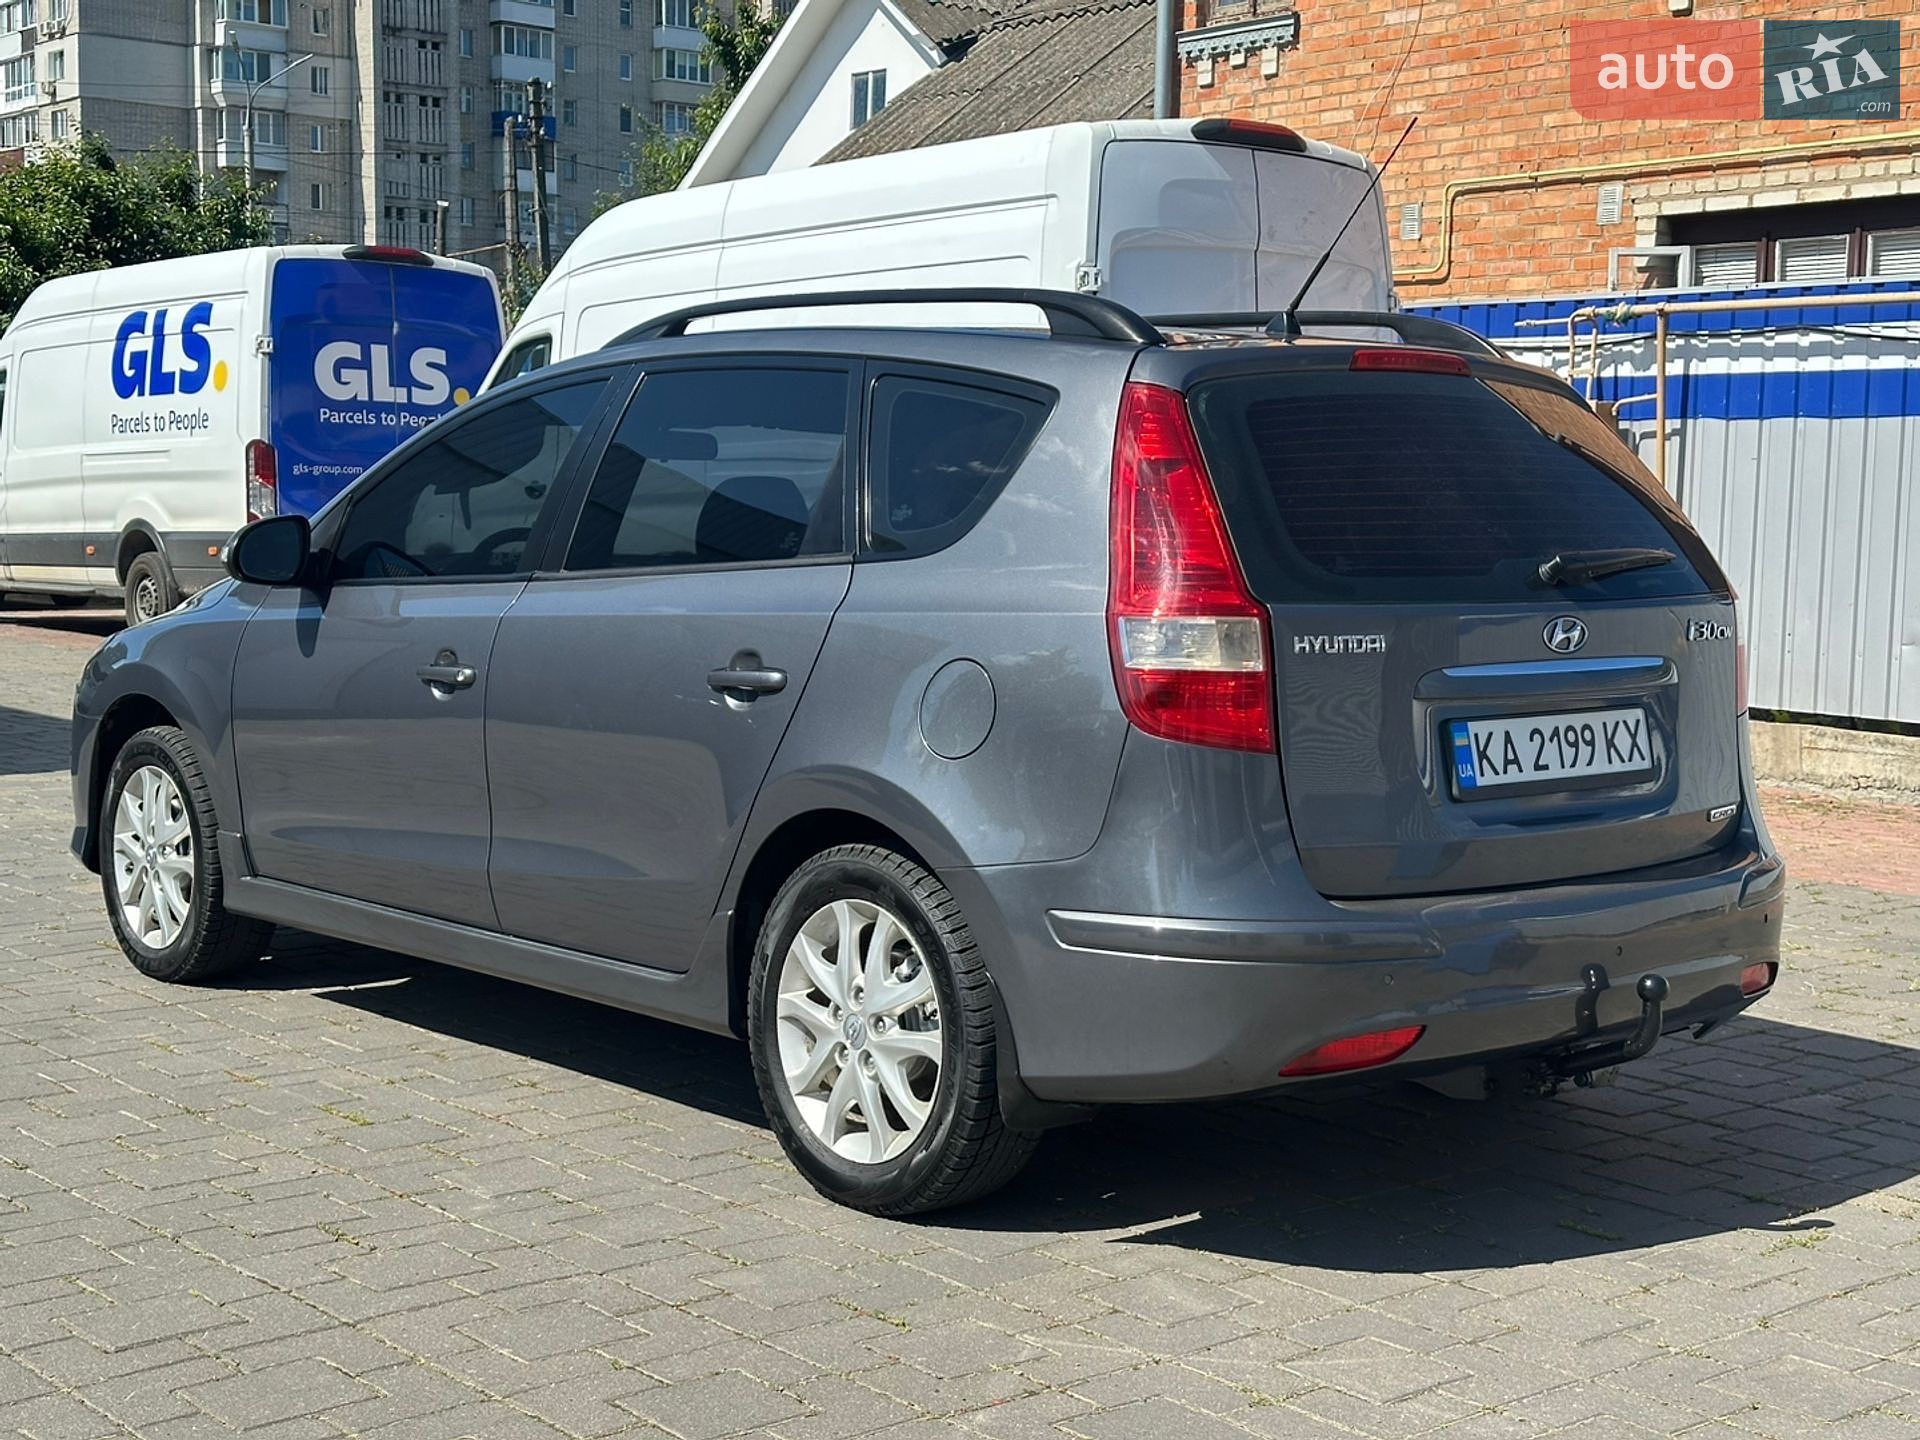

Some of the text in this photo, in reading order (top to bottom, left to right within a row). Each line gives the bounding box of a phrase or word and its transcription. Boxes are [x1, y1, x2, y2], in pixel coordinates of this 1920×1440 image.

[111, 406, 209, 437] Parcels to People
[319, 407, 377, 425] Parcels
[380, 412, 397, 426] to
[292, 462, 364, 476] gls-group.com
[1293, 634, 1386, 654] HYUNDAI
[1473, 718, 1647, 778] KA 2199 KX
[1458, 763, 1475, 778] UA
